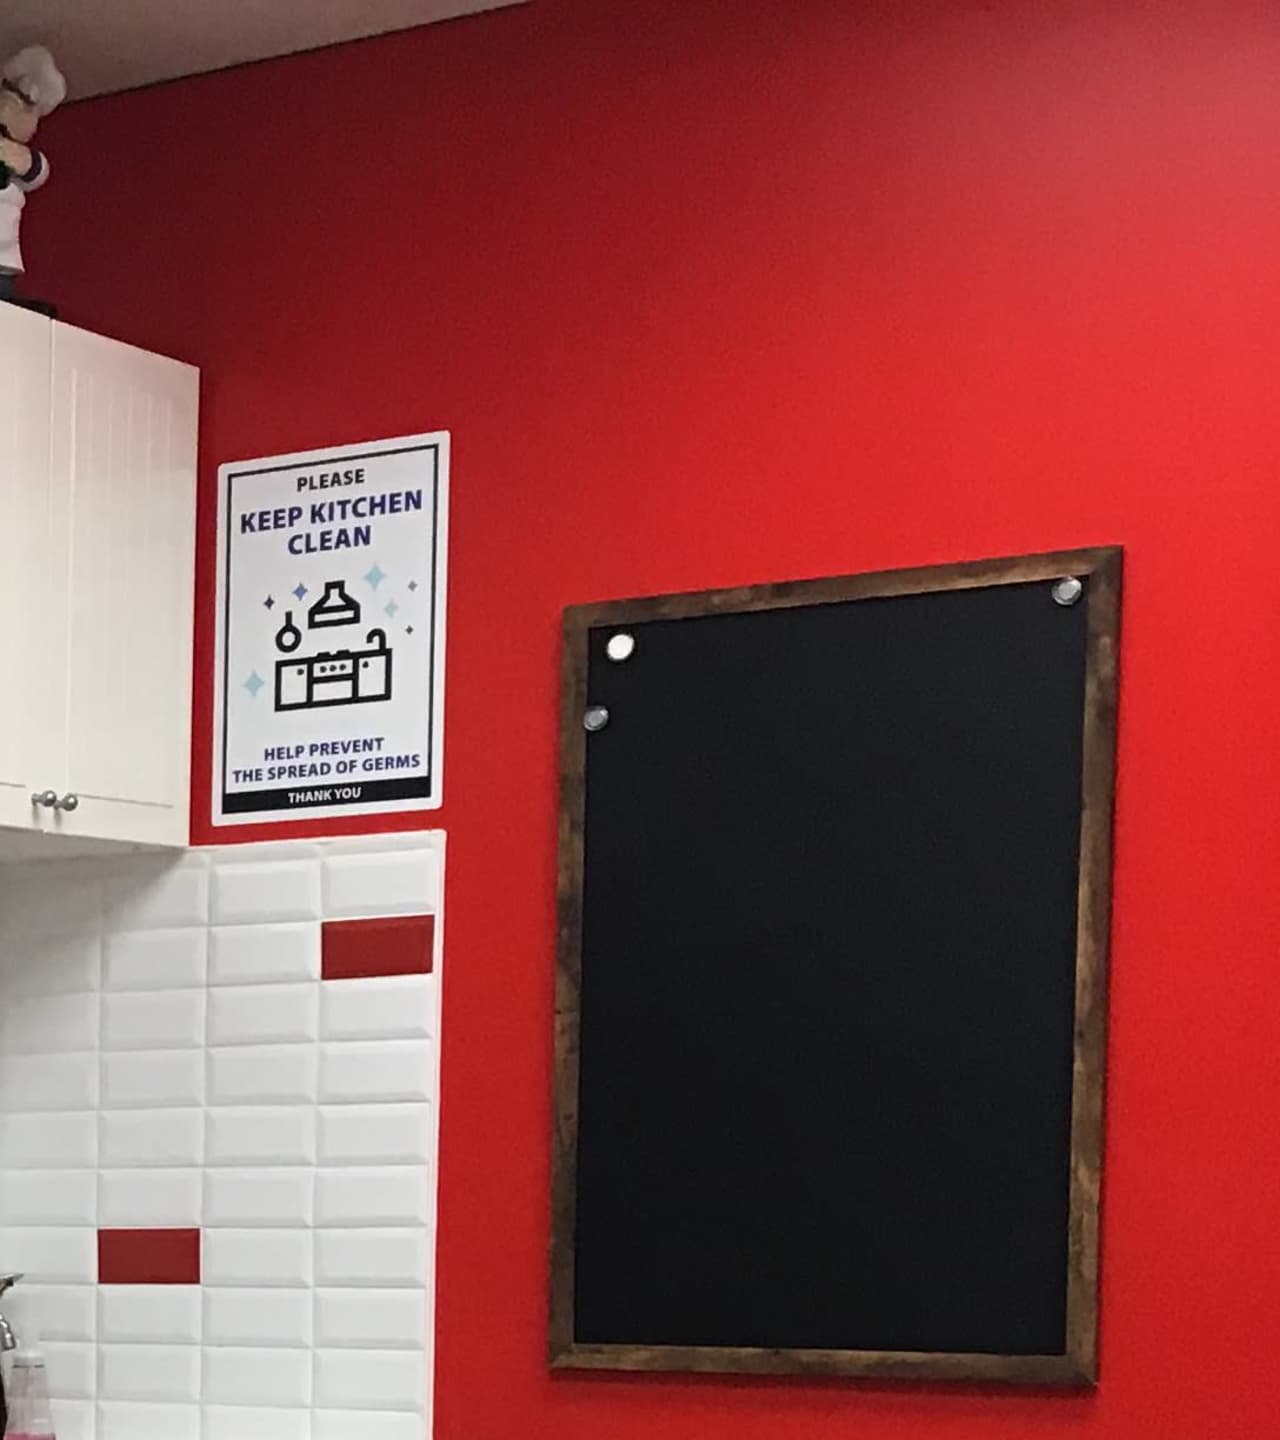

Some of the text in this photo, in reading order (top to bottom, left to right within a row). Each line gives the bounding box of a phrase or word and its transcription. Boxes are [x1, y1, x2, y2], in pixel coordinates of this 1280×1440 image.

[297, 468, 365, 492] PLEASE
[240, 489, 423, 534] KEEP KITCHEN
[287, 525, 371, 556] CLEAN
[264, 736, 385, 762] HELP PREVENT
[233, 754, 421, 784] THE SPREAD OF GERMS
[288, 787, 362, 804] THANK YOU
